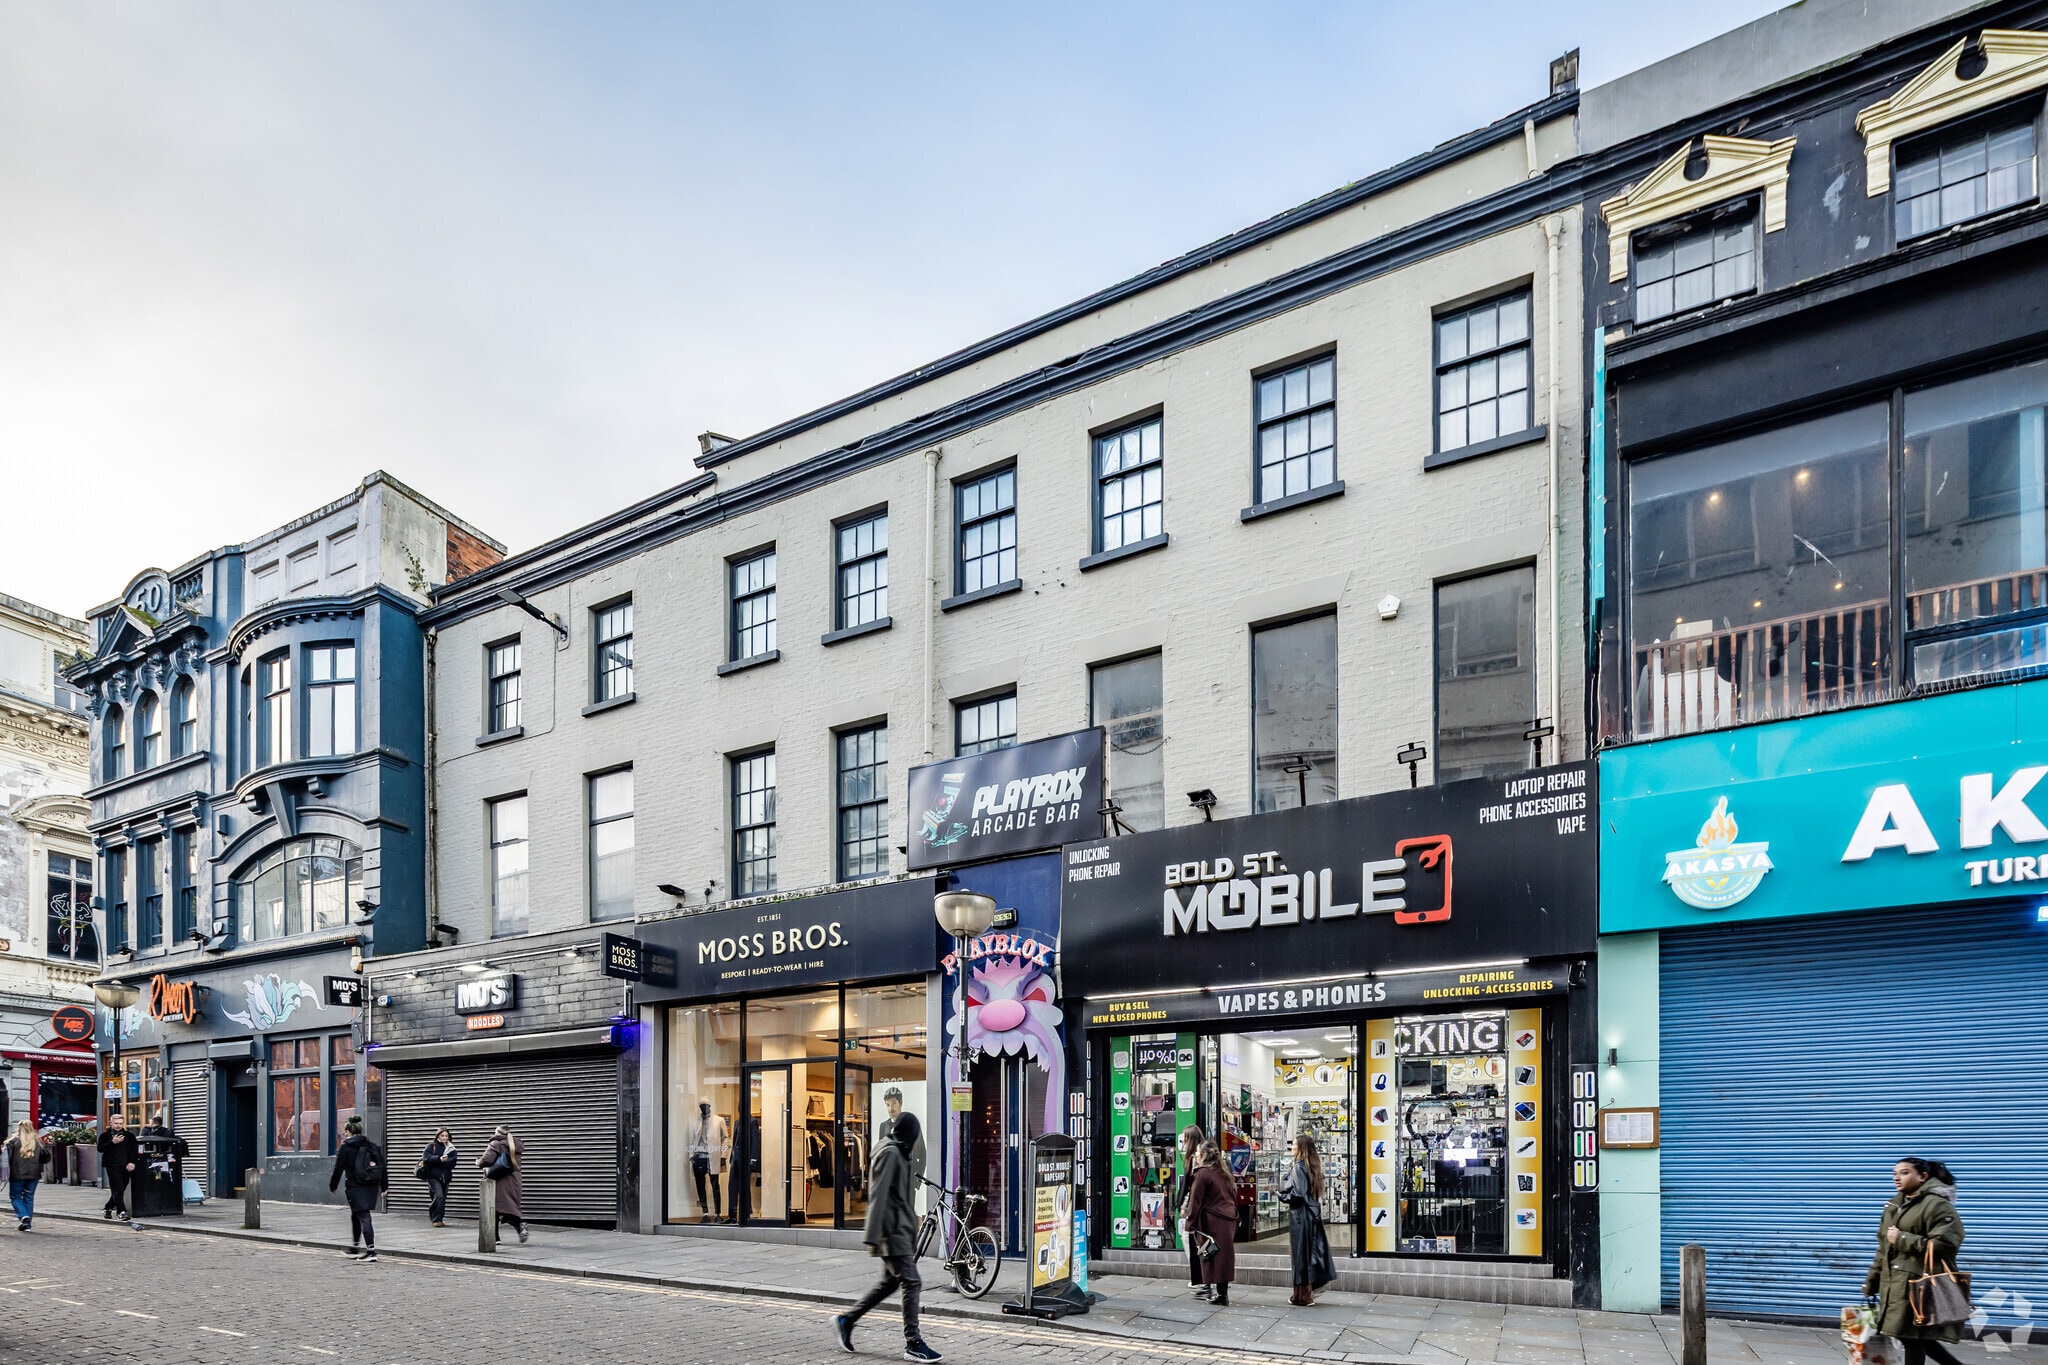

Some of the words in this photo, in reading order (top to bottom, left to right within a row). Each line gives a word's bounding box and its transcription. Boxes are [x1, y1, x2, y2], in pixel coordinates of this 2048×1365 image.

[134, 583, 162, 613] 50
[971, 766, 1087, 819] PLAYBOX
[1505, 776, 1545, 799] LAPTOP
[1547, 769, 1586, 792] REPAIR
[971, 809, 1038, 837] ARCADE
[1045, 802, 1080, 825] BAR
[1479, 803, 1512, 824] PHONE
[1515, 792, 1586, 819] ACCESSORIES
[1557, 814, 1586, 835] VAPE
[1069, 845, 1110, 865] UNLOCKING
[1667, 852, 1770, 878] AKASYA
[1069, 866, 1093, 883] PHONE
[1094, 861, 1120, 879] REPAIR
[1165, 857, 1235, 887] BOLD
[1242, 850, 1288, 877] ST.
[1163, 857, 1407, 937] MOBILE
[612, 944, 636, 958] MOSS
[698, 933, 765, 964] MOSS
[772, 921, 849, 955] BROS.
[612, 954, 638, 969] BROS.
[721, 970, 746, 979] BESPOKE
[809, 960, 824, 969] HIRE
[332, 980, 358, 992] MO'S
[1459, 970, 1515, 984] REPAIRING
[457, 979, 508, 1009] MO'S
[1109, 1003, 1125, 1012] BUY
[1133, 1000, 1150, 1010] SELL
[1218, 991, 1279, 1014] VAPES
[1283, 990, 1299, 1009] &
[1302, 982, 1387, 1007] PHONES
[468, 1016, 500, 1028] NOODLES
[1092, 1014, 1110, 1024] NEW
[1116, 1012, 1136, 1022] USED
[1136, 1010, 1167, 1021] PHONES
